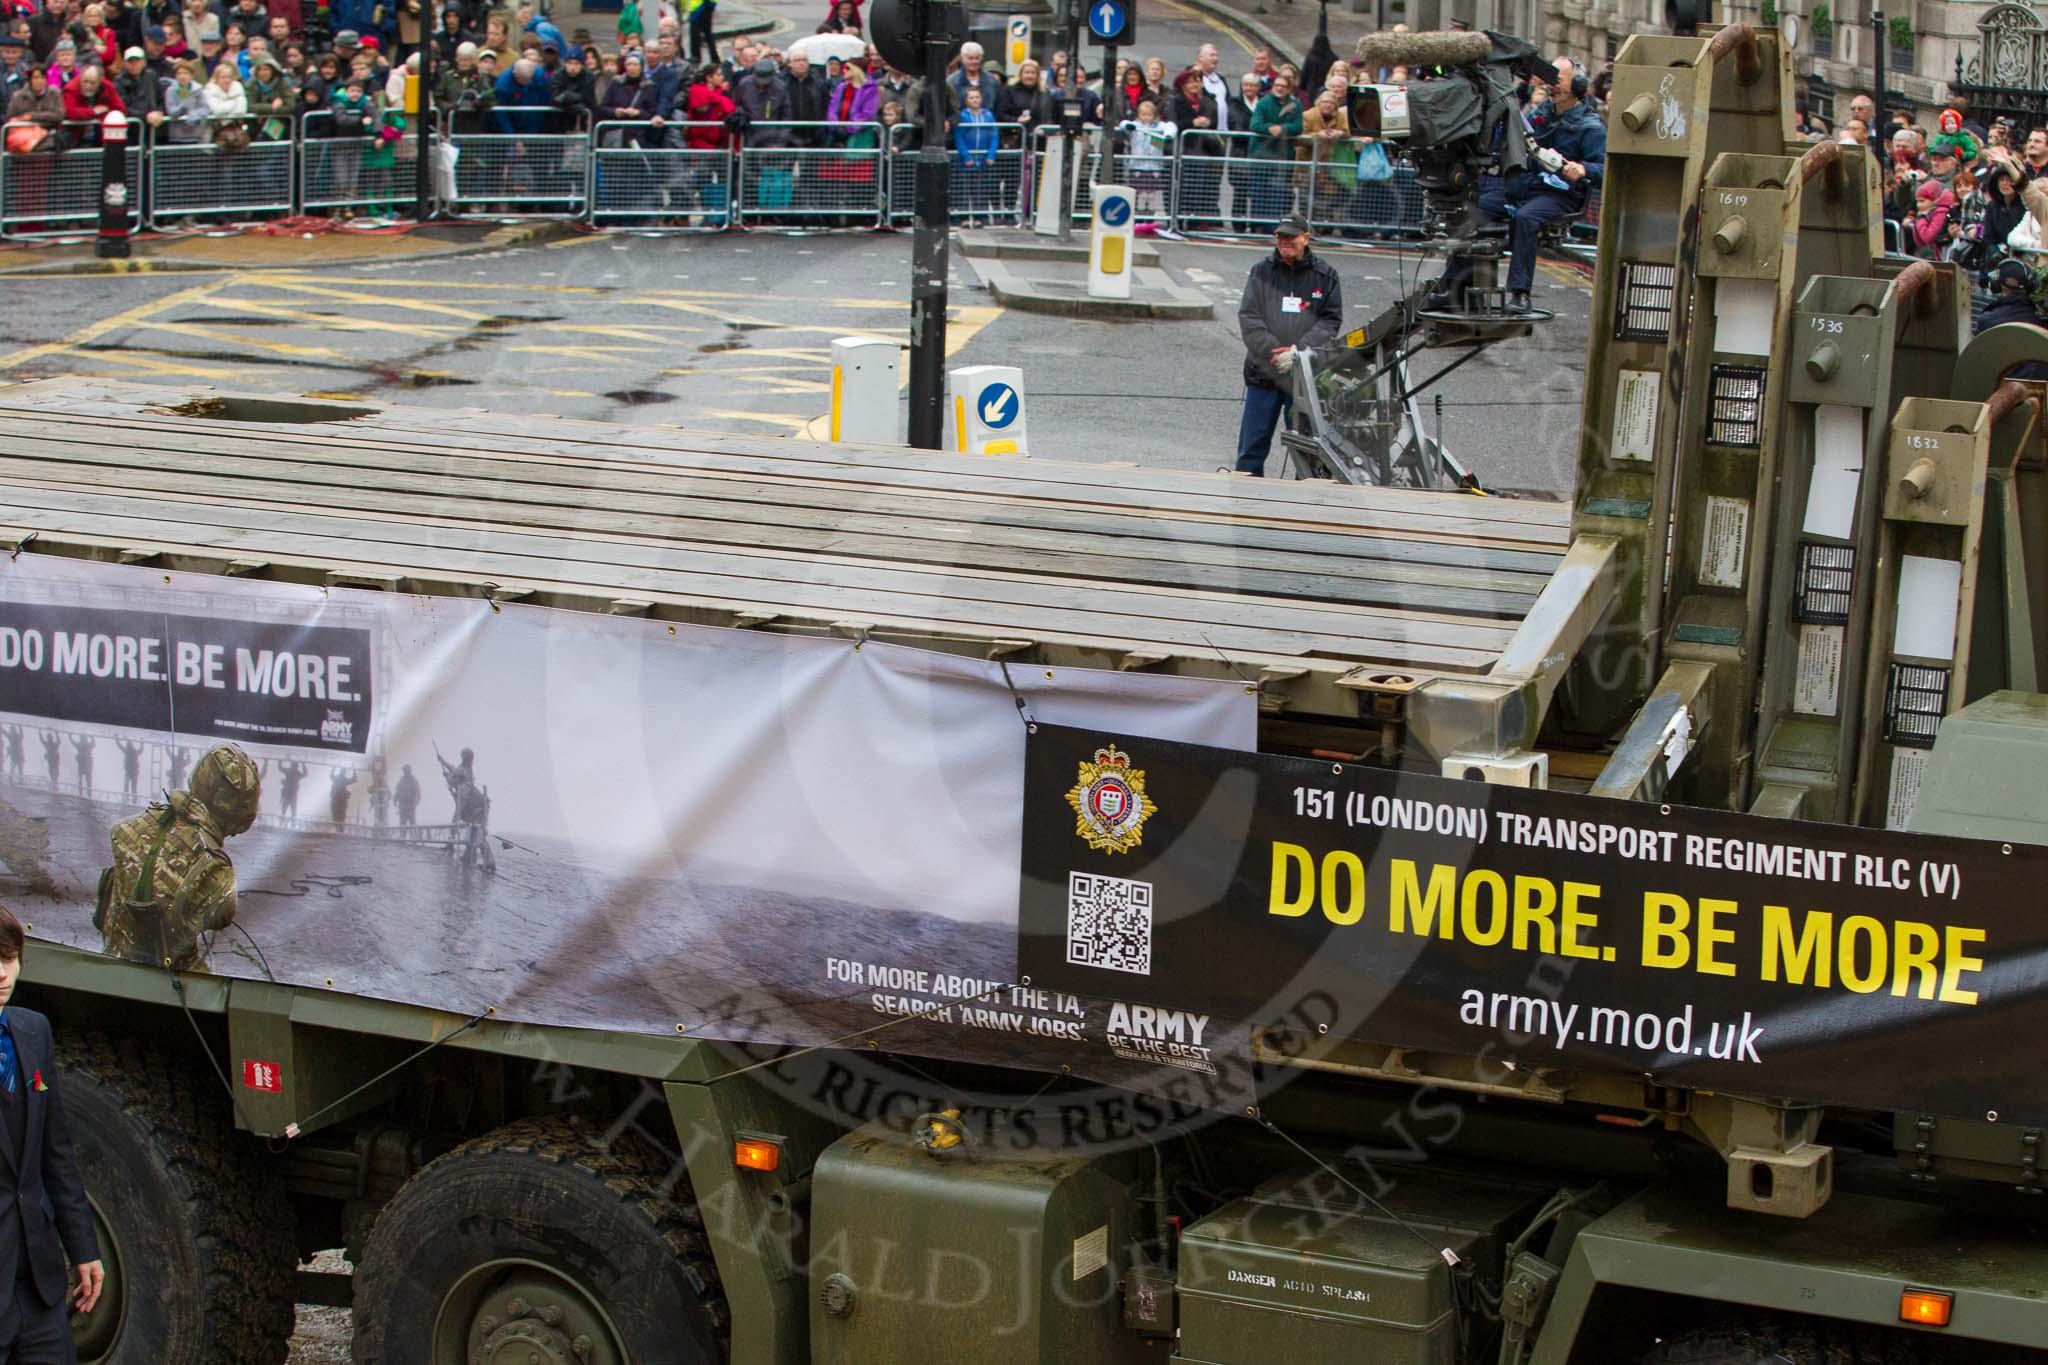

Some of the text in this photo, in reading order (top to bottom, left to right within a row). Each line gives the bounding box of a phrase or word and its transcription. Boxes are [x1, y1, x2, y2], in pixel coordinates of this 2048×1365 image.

[1720, 193, 1748, 206] 1619
[1810, 317, 1843, 333] 1536
[0, 627, 361, 701] DO MORE. BE MORE.
[1293, 786, 1961, 900] 151 (LONDON) TRANSPORT REGIMENT RLC (V)
[1268, 841, 1987, 1006] DO MORE. BE MORE
[826, 957, 864, 984] FOR
[867, 966, 929, 991] MORE
[932, 974, 1002, 1005] ABOUT
[1006, 983, 1050, 1012] THE
[872, 992, 952, 1025] SEARCH
[1107, 1001, 1210, 1045] ARMY
[1459, 988, 1763, 1064] army.mod.uk
[1106, 1033, 1211, 1061] BE THE BEST
[1227, 1269, 1371, 1303] DANGER ACID SPLASH
